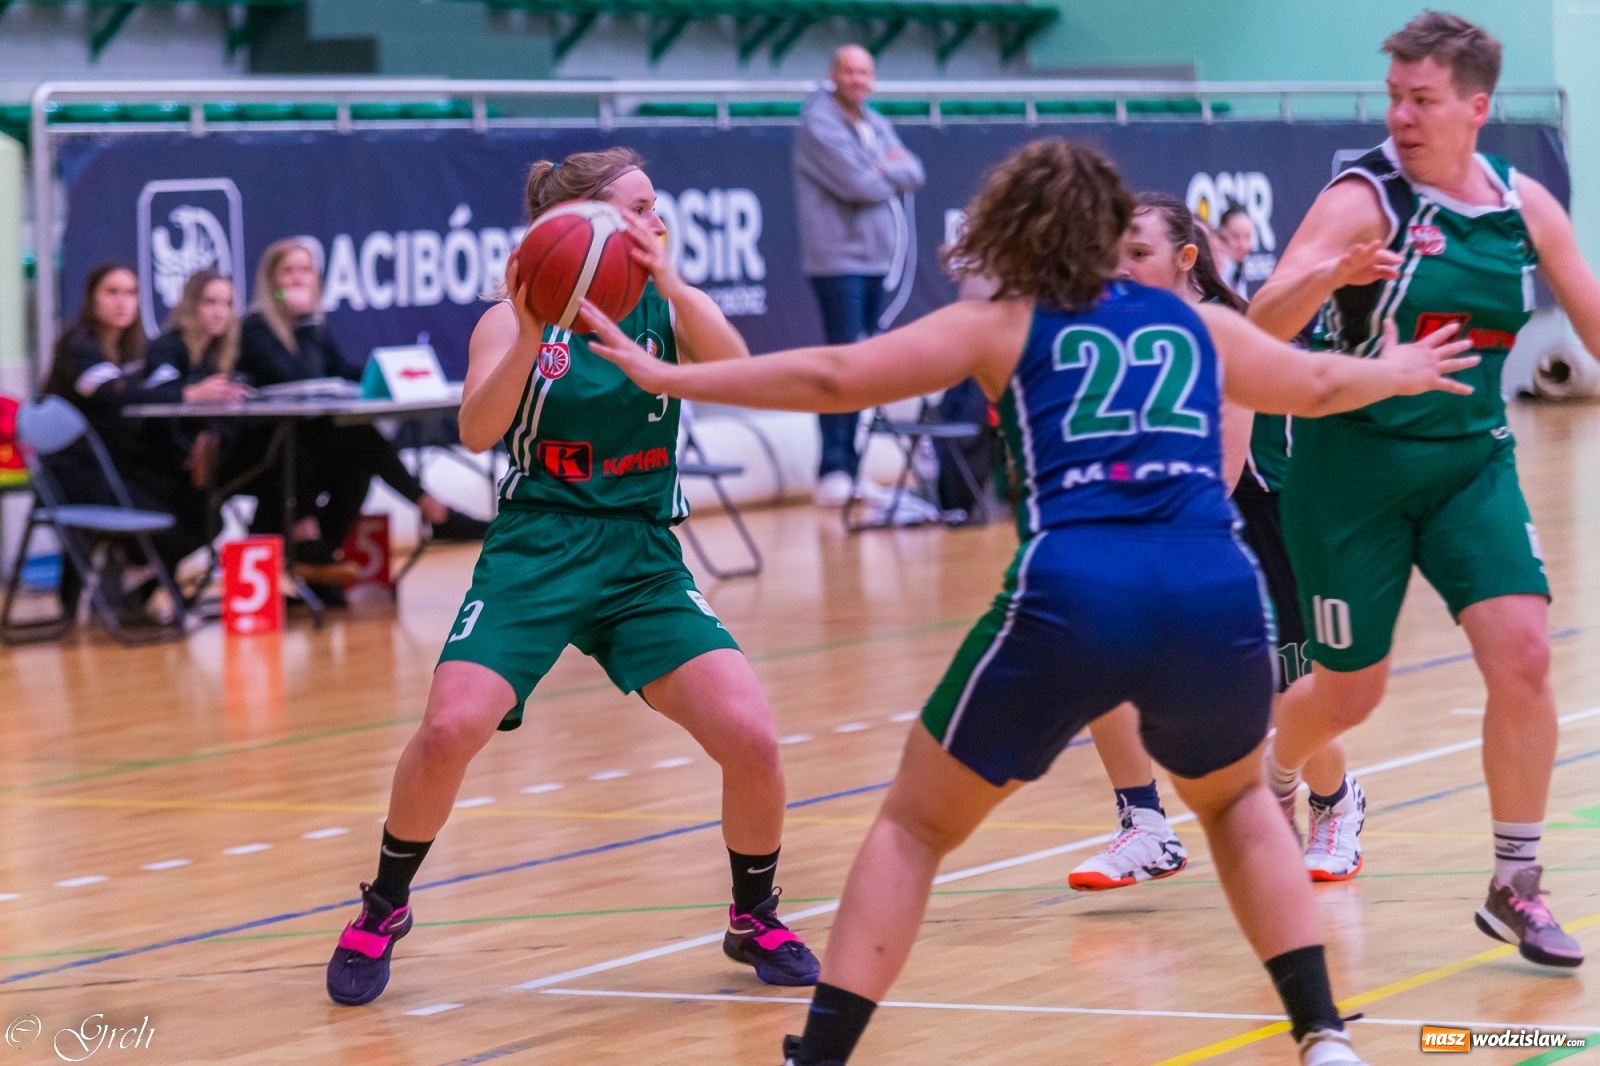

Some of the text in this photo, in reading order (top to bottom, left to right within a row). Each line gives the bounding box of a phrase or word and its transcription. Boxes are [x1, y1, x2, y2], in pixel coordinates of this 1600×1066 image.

[296, 202, 527, 312] ACIBÓR
[1052, 324, 1209, 443] 22
[603, 446, 670, 476] KAMAN
[229, 545, 274, 614] 5
[448, 600, 485, 643] 3
[1312, 595, 1352, 649] 10
